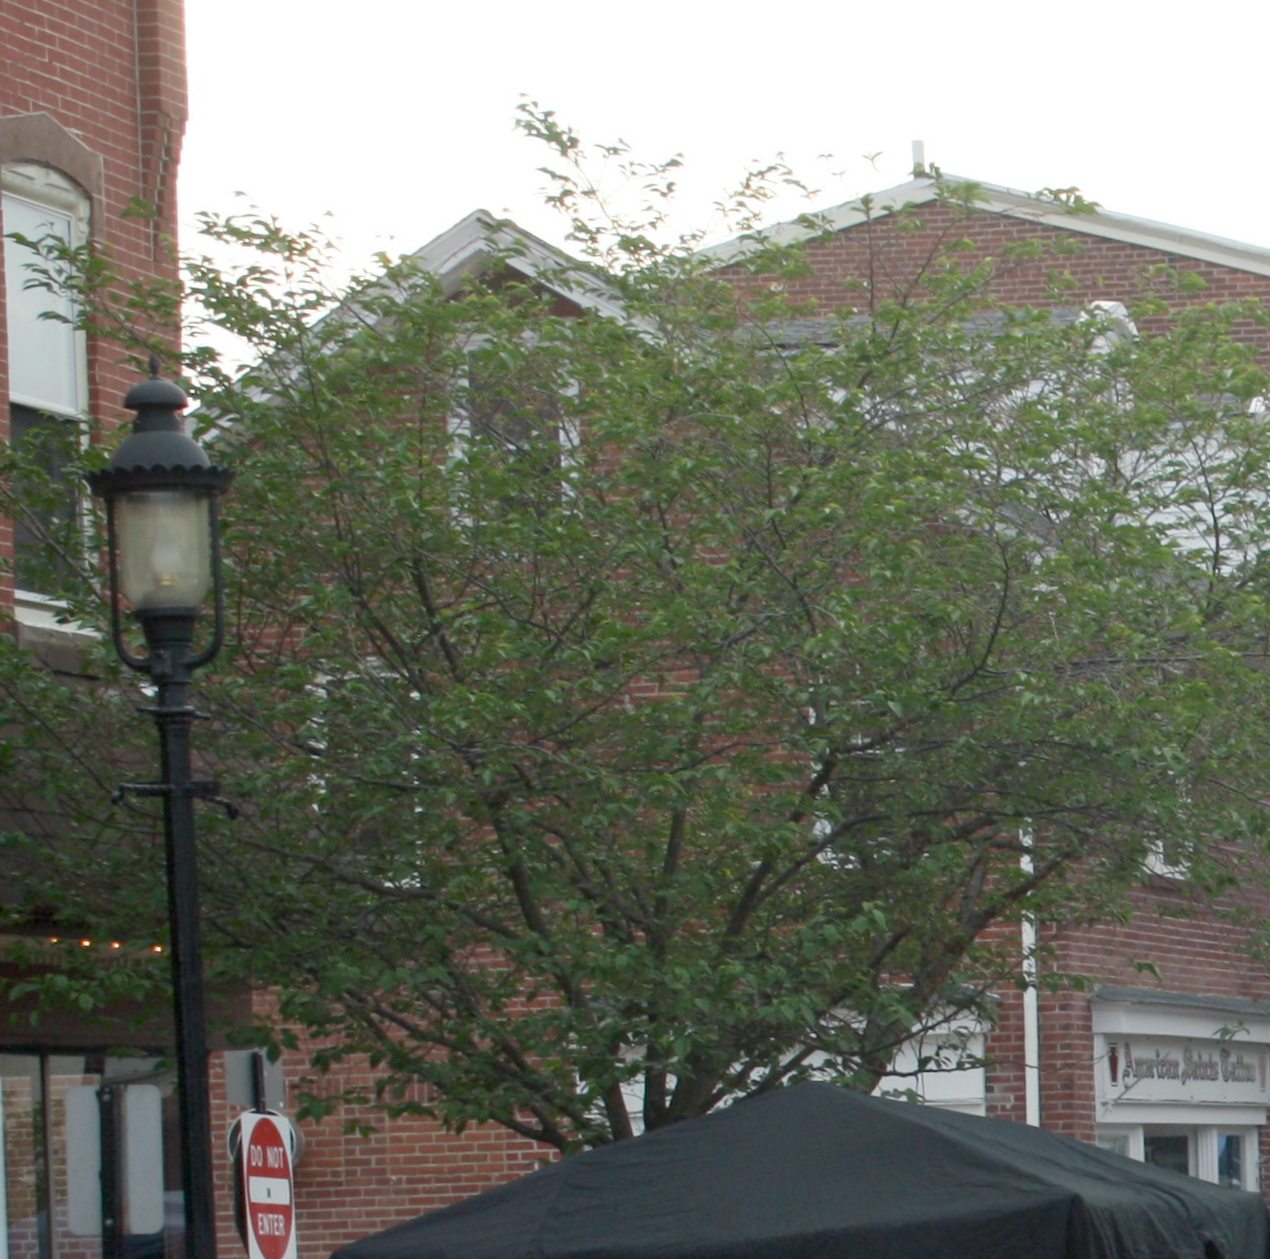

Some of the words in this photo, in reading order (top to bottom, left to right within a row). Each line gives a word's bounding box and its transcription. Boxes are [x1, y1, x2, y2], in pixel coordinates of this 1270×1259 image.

[250, 1144, 263, 1168] DO
[267, 1145, 285, 1169] NOT
[257, 1212, 286, 1237] ENTER
